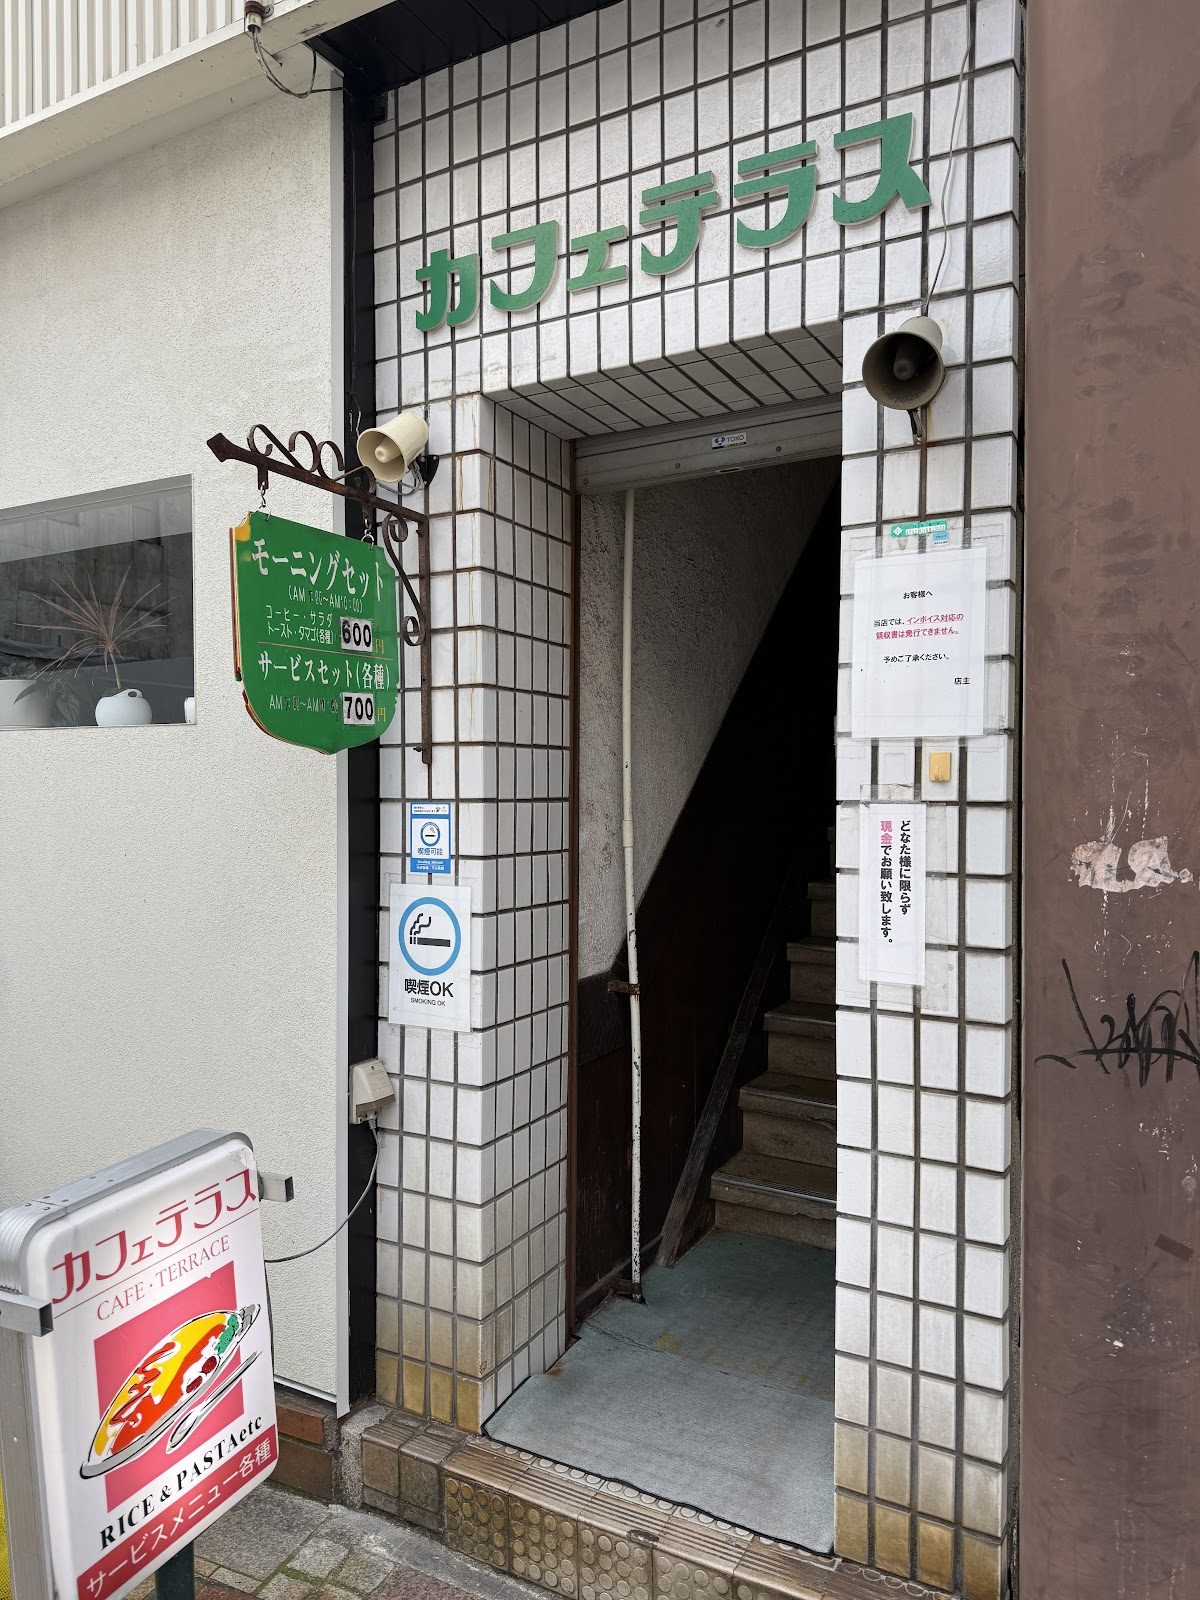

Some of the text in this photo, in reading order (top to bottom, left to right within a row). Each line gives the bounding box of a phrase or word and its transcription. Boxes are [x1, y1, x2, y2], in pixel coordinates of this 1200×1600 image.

[416, 112, 932, 332] カフェテラス
[252, 538, 383, 602] モーニングセット
[903, 590, 933, 600] お客様へ
[258, 650, 390, 691] サービスセット(各種)
[883, 653, 950, 664] 予めご了承ください。
[954, 677, 971, 686] 店主
[880, 820, 893, 943] 現金でお願い致します。
[899, 819, 912, 916] どなた様に限らず
[404, 978, 454, 998] 喫煙OK
[52, 1168, 256, 1305] カフェテラス
[86, 1437, 272, 1598] サービスメニュー各種
[99, 1494, 156, 1551] RICE
